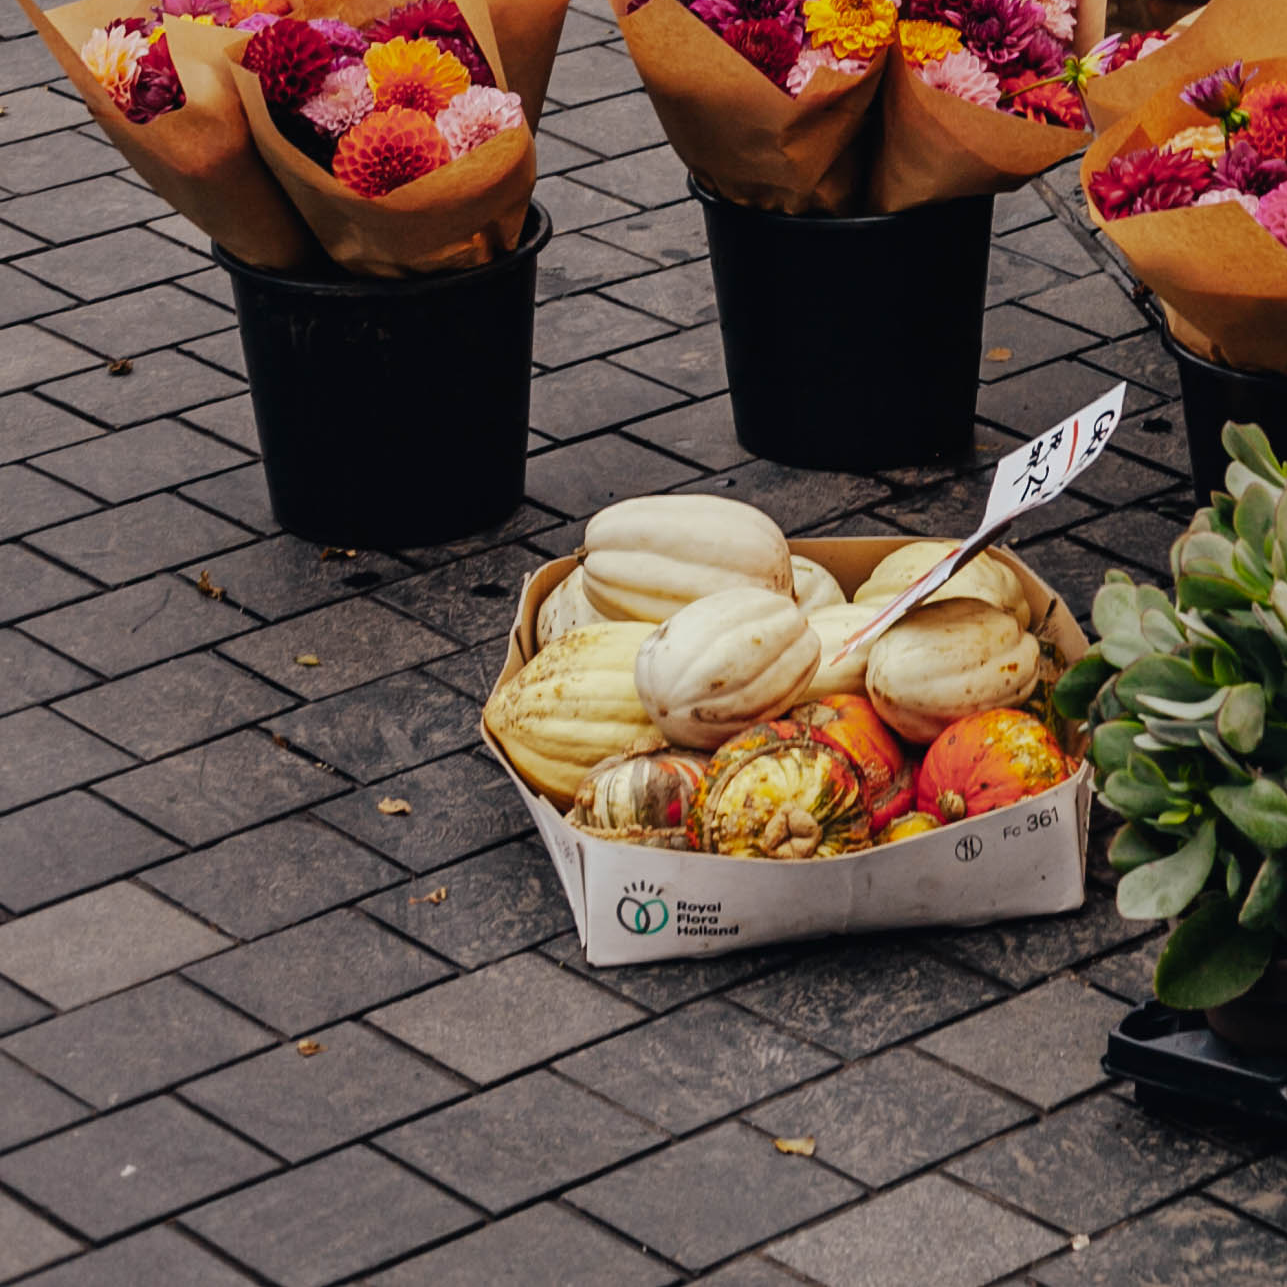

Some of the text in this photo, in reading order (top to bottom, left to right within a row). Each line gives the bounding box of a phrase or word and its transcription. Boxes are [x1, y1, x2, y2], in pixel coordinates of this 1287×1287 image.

[1026, 806, 1059, 832] 361
[677, 900, 721, 914] Royal
[677, 913, 719, 925] Flora
[677, 924, 739, 936] Holland
